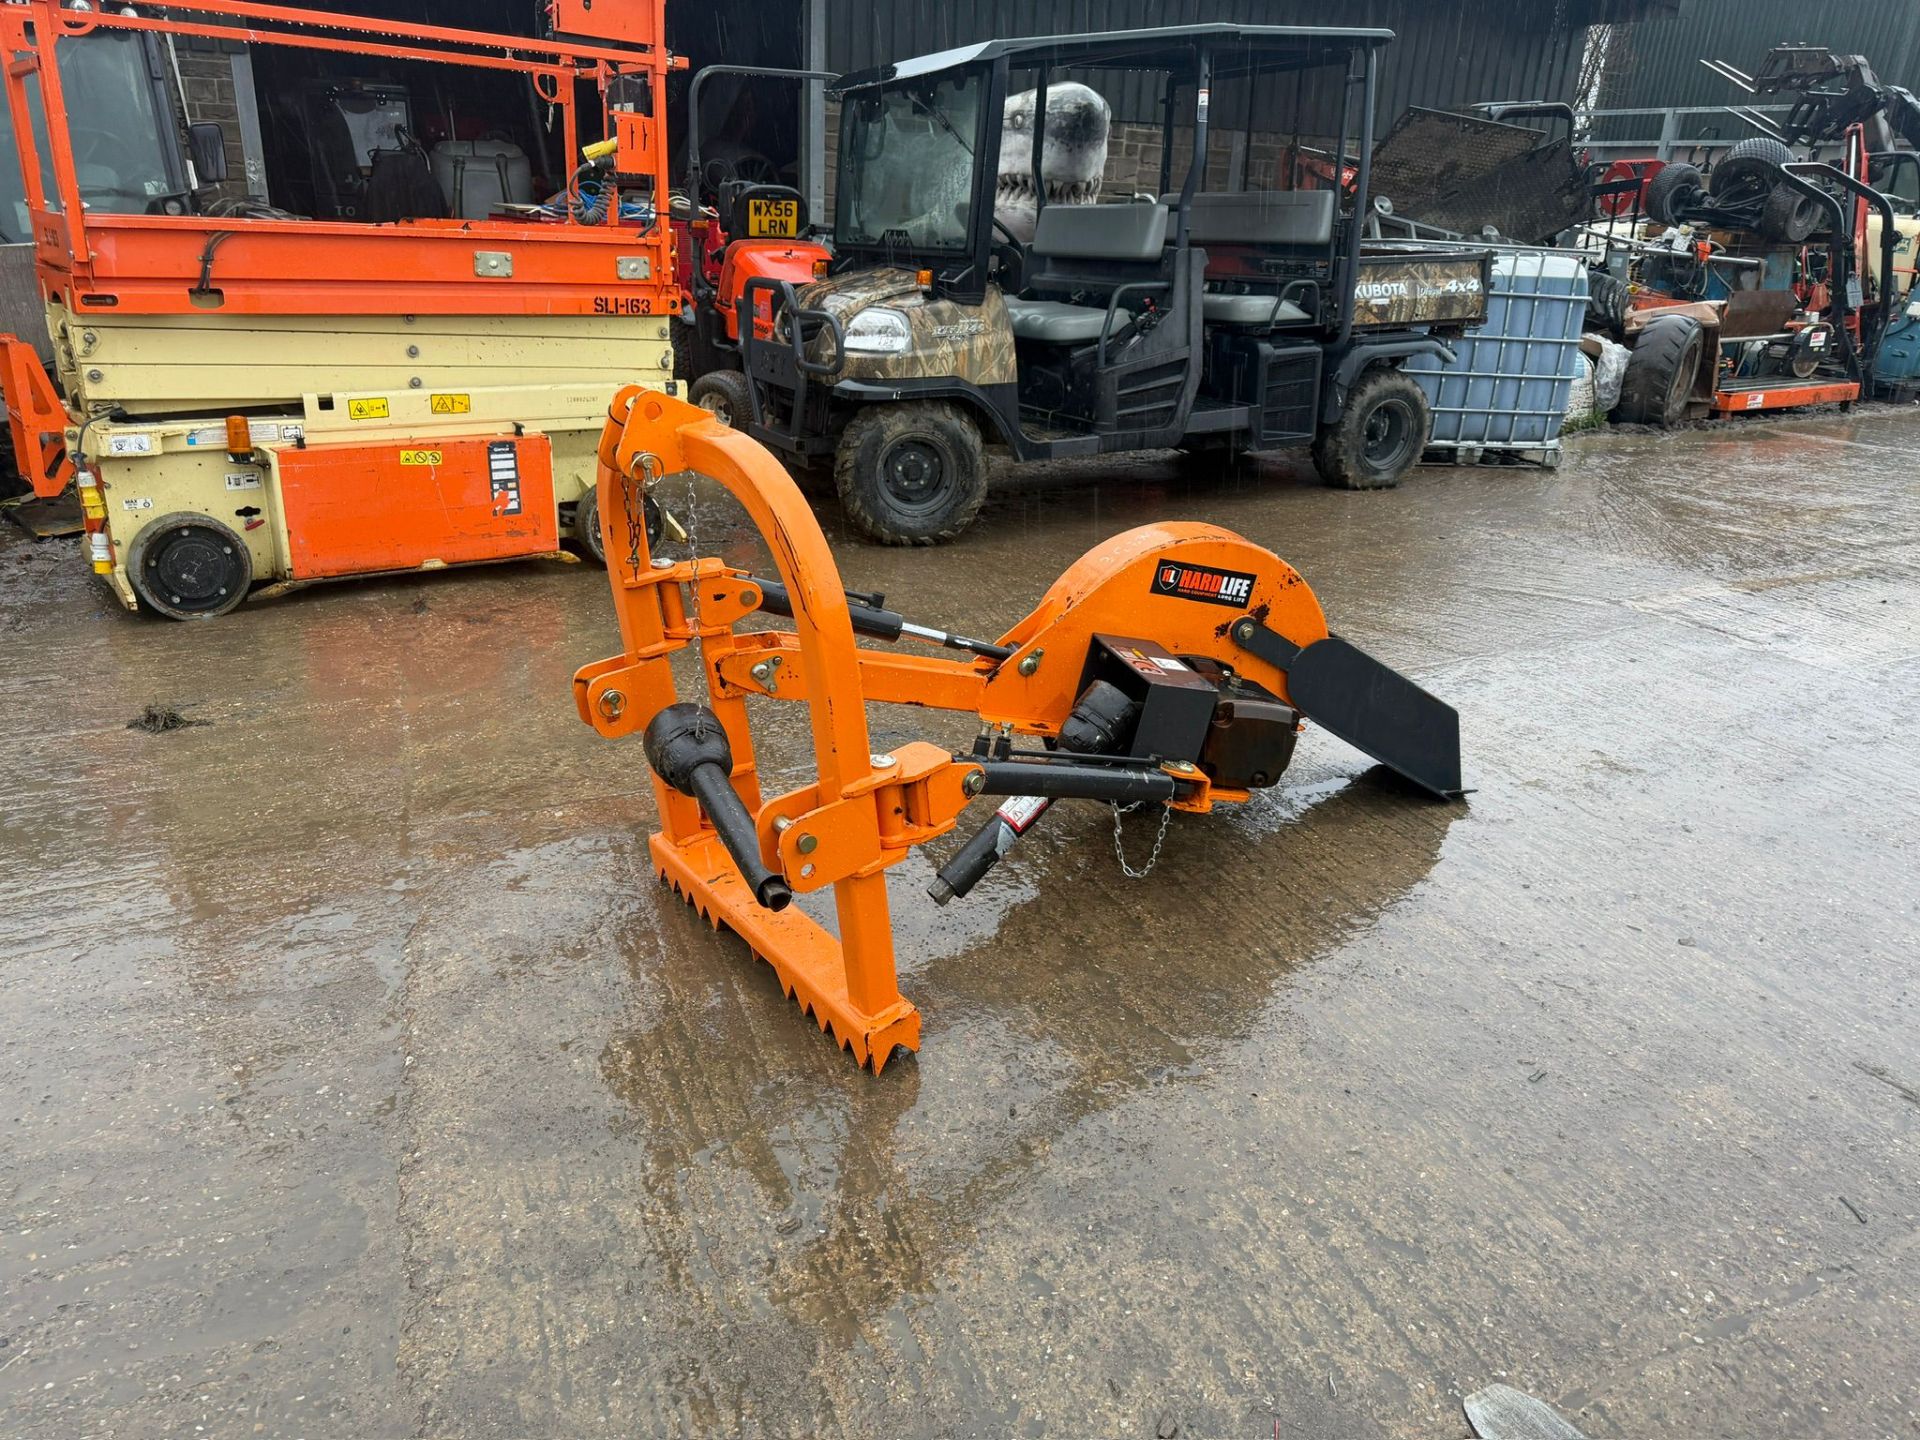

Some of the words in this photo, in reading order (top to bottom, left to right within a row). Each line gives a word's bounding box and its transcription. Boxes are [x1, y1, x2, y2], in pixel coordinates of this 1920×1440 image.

[753, 201, 793, 217] WX56
[758, 219, 788, 234] LRN
[1354, 282, 1408, 299] KUBOTA
[1444, 279, 1479, 293] 4x4
[1162, 569, 1176, 583] HL
[1179, 569, 1251, 597] HARDLIFE
